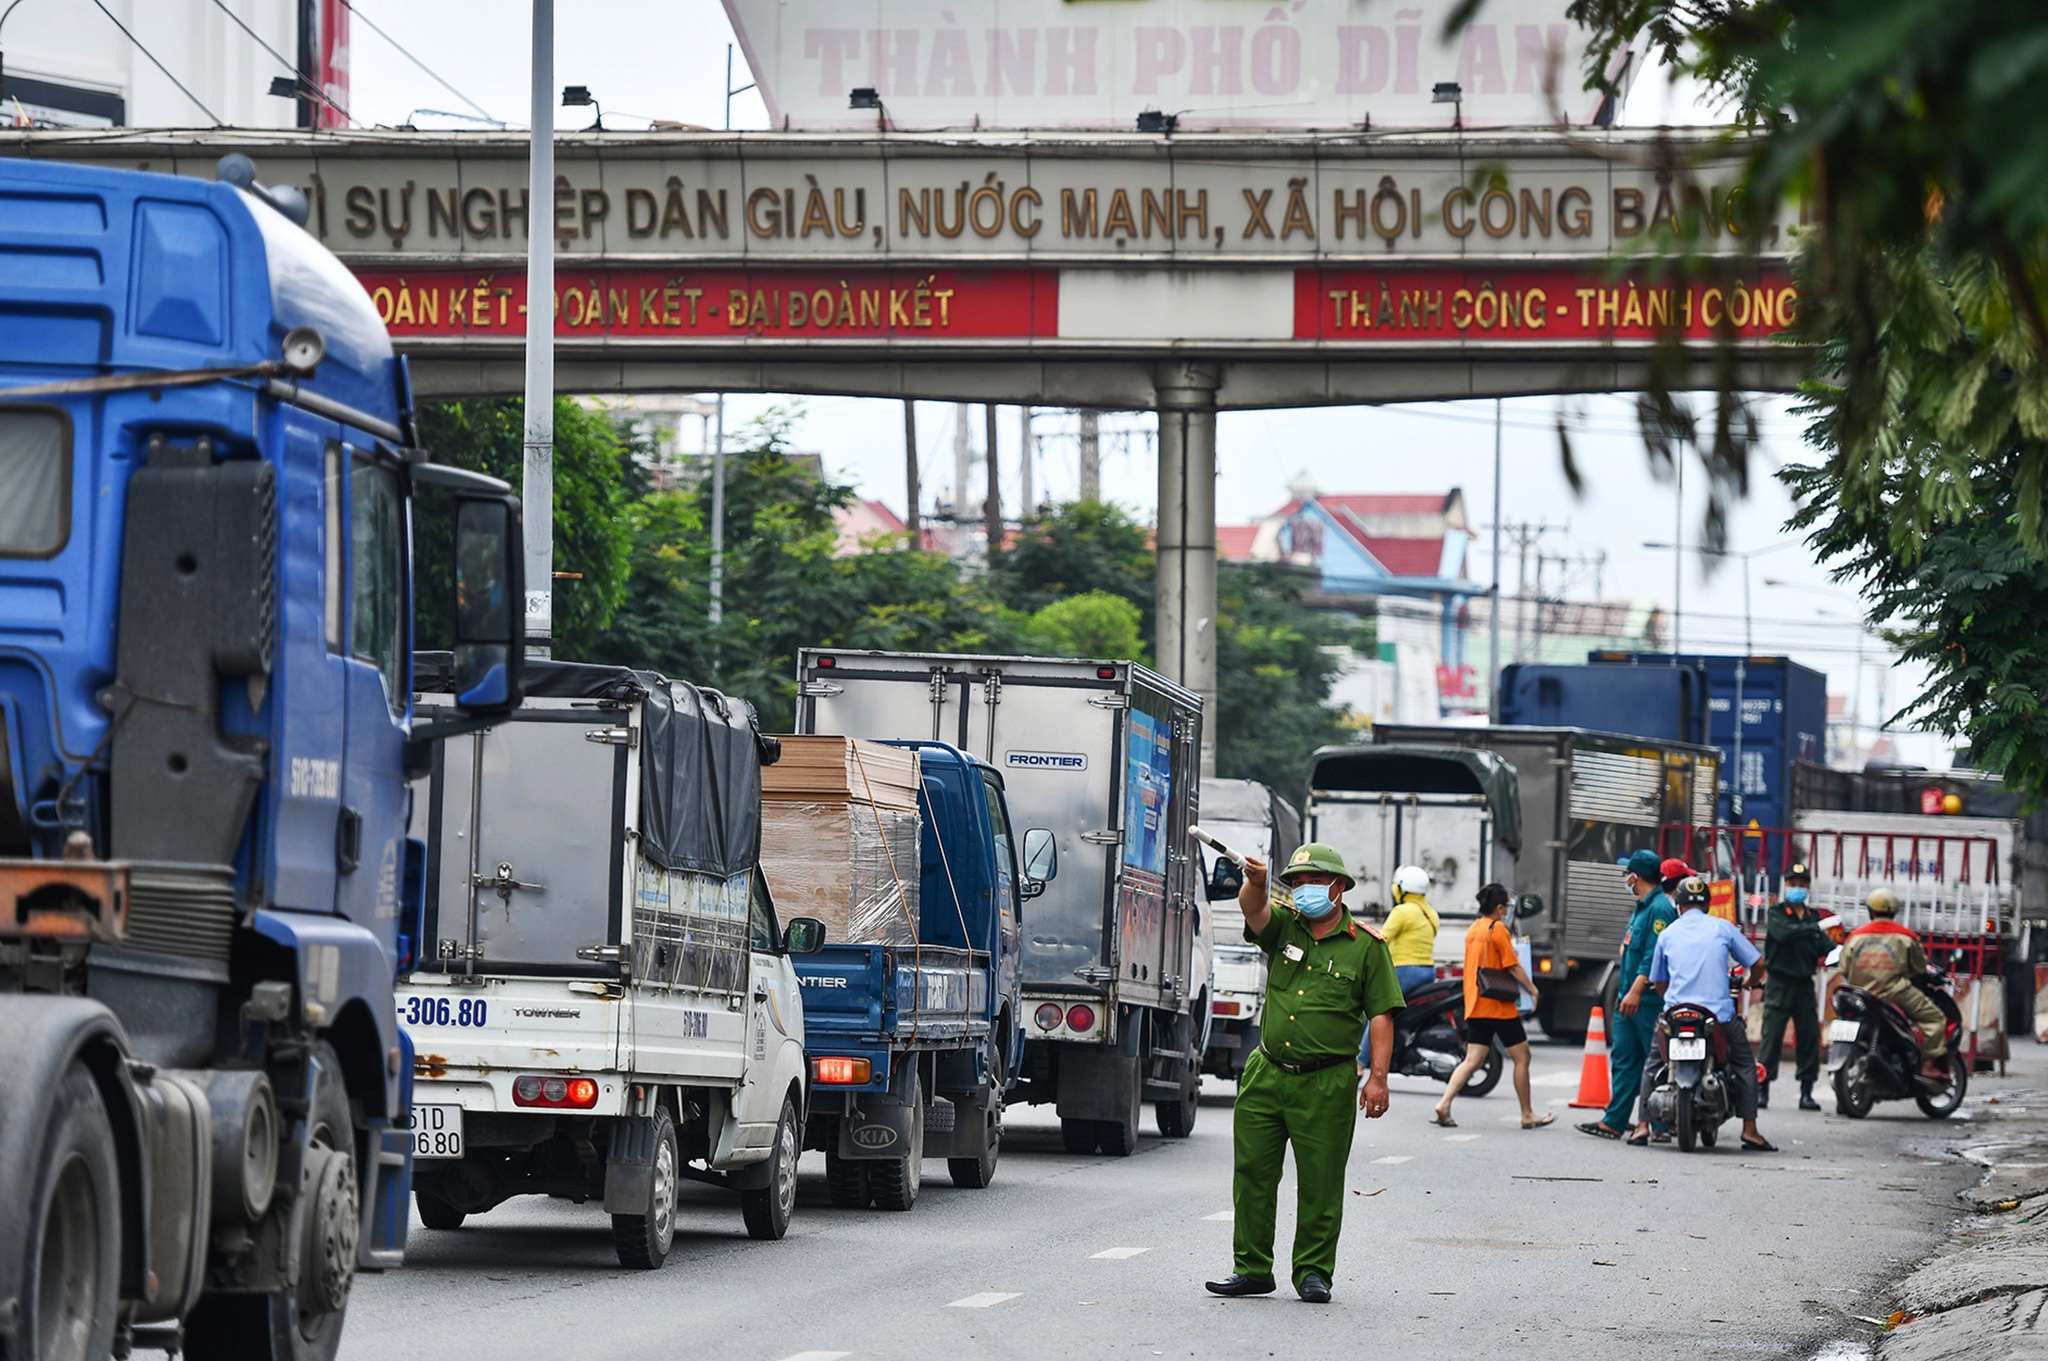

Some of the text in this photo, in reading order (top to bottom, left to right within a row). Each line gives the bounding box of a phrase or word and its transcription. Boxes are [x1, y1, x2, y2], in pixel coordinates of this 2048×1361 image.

[804, 0, 1569, 97] THÀNH PHỐ DĨ AN
[345, 180, 416, 249] SỰ
[426, 174, 611, 249] NGHỆP
[625, 175, 730, 239] DÂN
[747, 173, 883, 248] GIÀU,
[899, 171, 1044, 239] NƯỚC
[1060, 187, 1225, 249] MẠNH,
[1242, 176, 1315, 240] XÃ
[1333, 175, 1422, 250] HỘI
[1442, 173, 1592, 239] CÔNG
[372, 279, 440, 327] OÀN
[449, 275, 513, 327] KẾT
[554, 279, 630, 327] OÀN
[639, 275, 703, 326] KẾT
[727, 288, 780, 336] ĐẠI
[788, 280, 880, 328] ĐOÀN
[889, 274, 954, 328] KẾT
[1328, 281, 1443, 330] THÀNH
[1452, 280, 1547, 330] CÔNG
[1575, 280, 1693, 328] THÀNH
[1701, 279, 1798, 328] CÔNG
[1009, 754, 1084, 767] FRONTIER
[397, 996, 488, 1028] -306.80
[513, 1006, 582, 1019] TOWNER
[413, 1132, 461, 1155] 6.80
[859, 1131, 891, 1143] KIA
